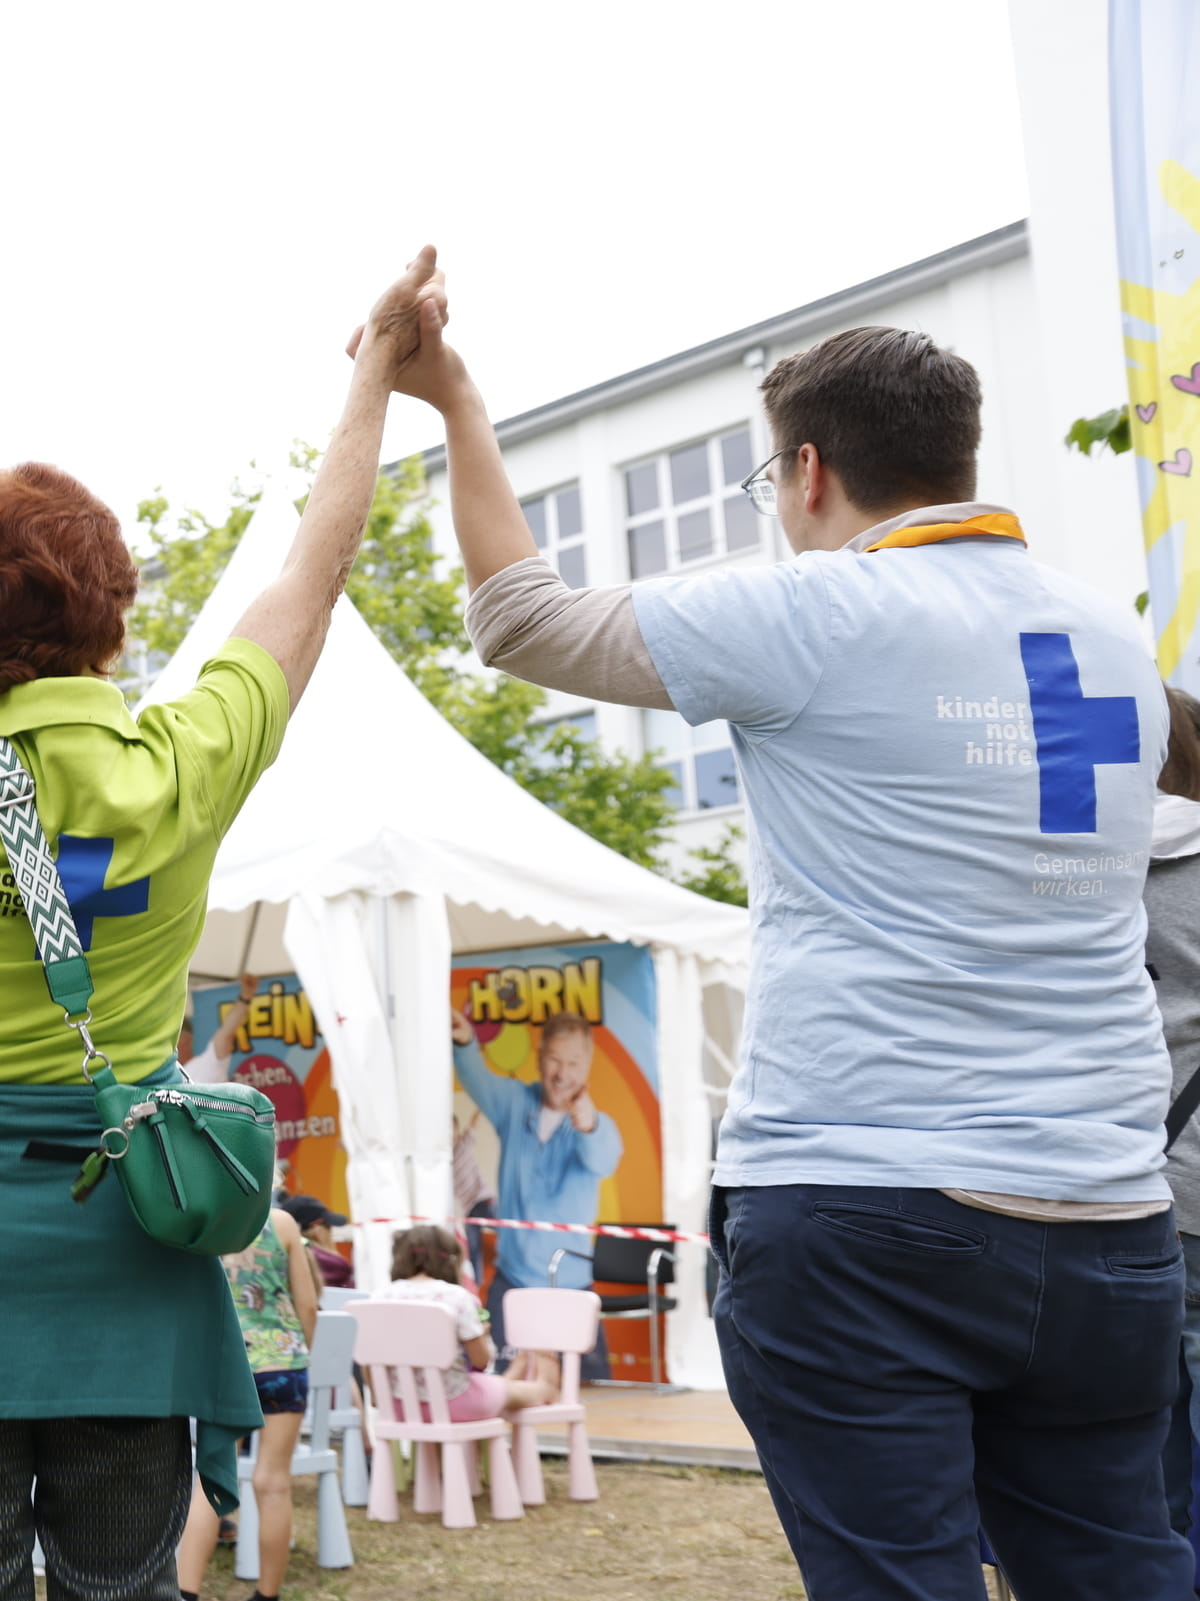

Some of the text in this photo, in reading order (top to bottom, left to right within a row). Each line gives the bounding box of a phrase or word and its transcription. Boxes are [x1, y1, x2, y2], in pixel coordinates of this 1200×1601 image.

[936, 695, 1027, 719] kinder
[986, 720, 1030, 742] not
[966, 741, 1033, 766] hilfe
[1032, 875, 1108, 896] wirken.
[469, 956, 604, 1025] HORN
